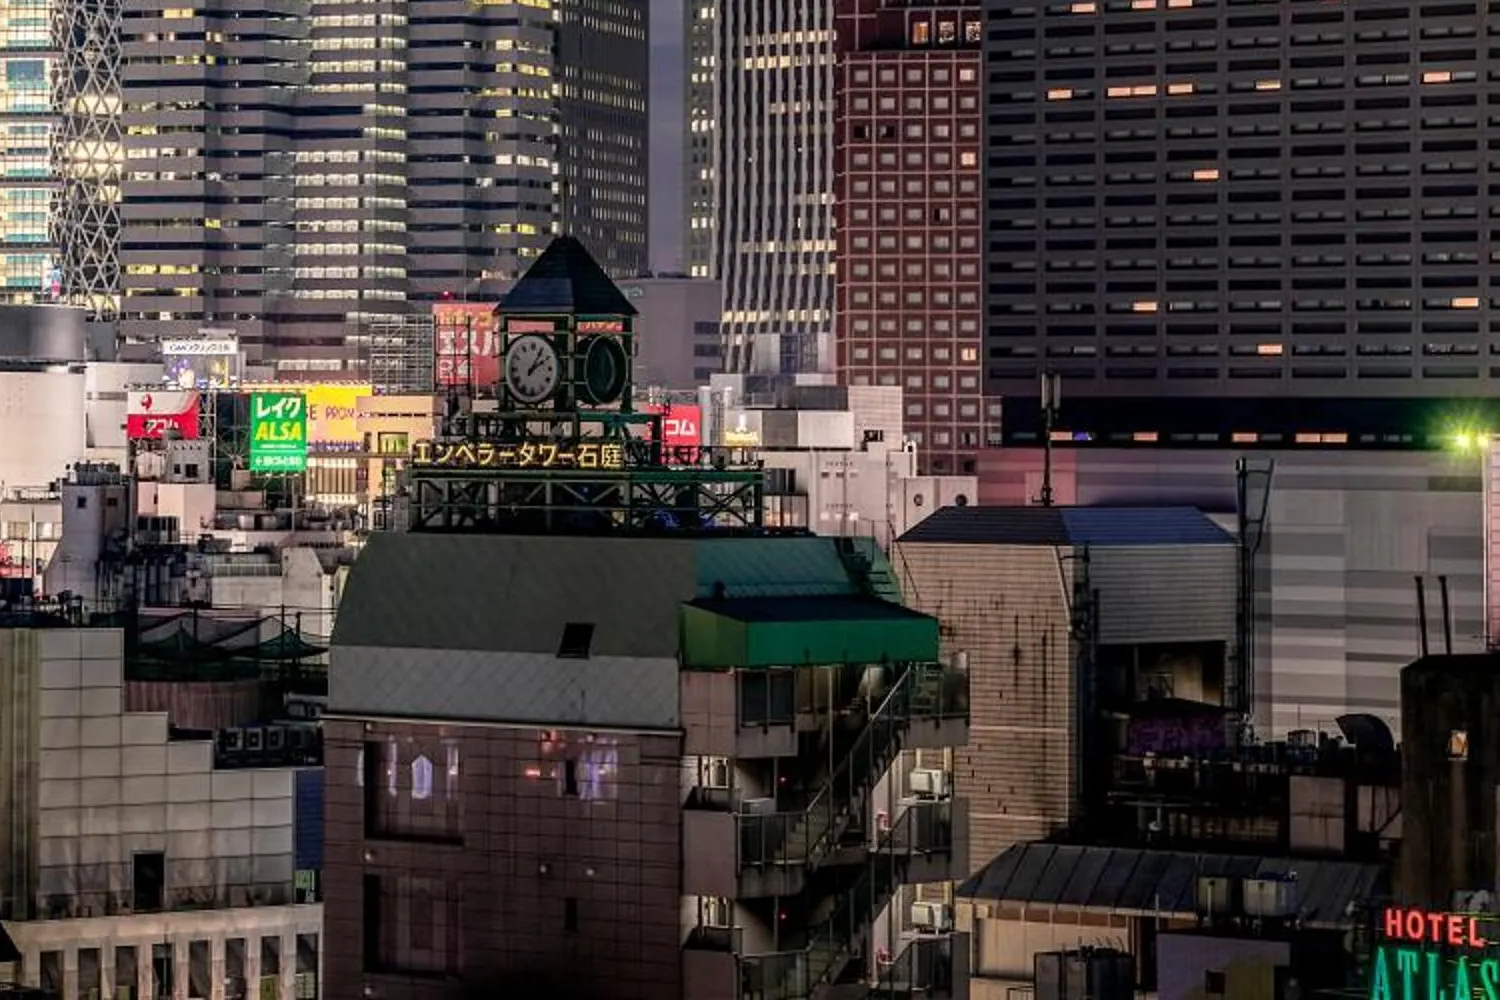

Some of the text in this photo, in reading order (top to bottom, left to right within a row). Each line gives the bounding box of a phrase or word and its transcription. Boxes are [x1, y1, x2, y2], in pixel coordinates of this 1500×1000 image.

[256, 396, 301, 419] レイク
[255, 421, 302, 441] ALSA
[663, 419, 697, 437] コム
[414, 442, 622, 468] エンペラータワー石庭
[1385, 908, 1485, 948] HOTEL
